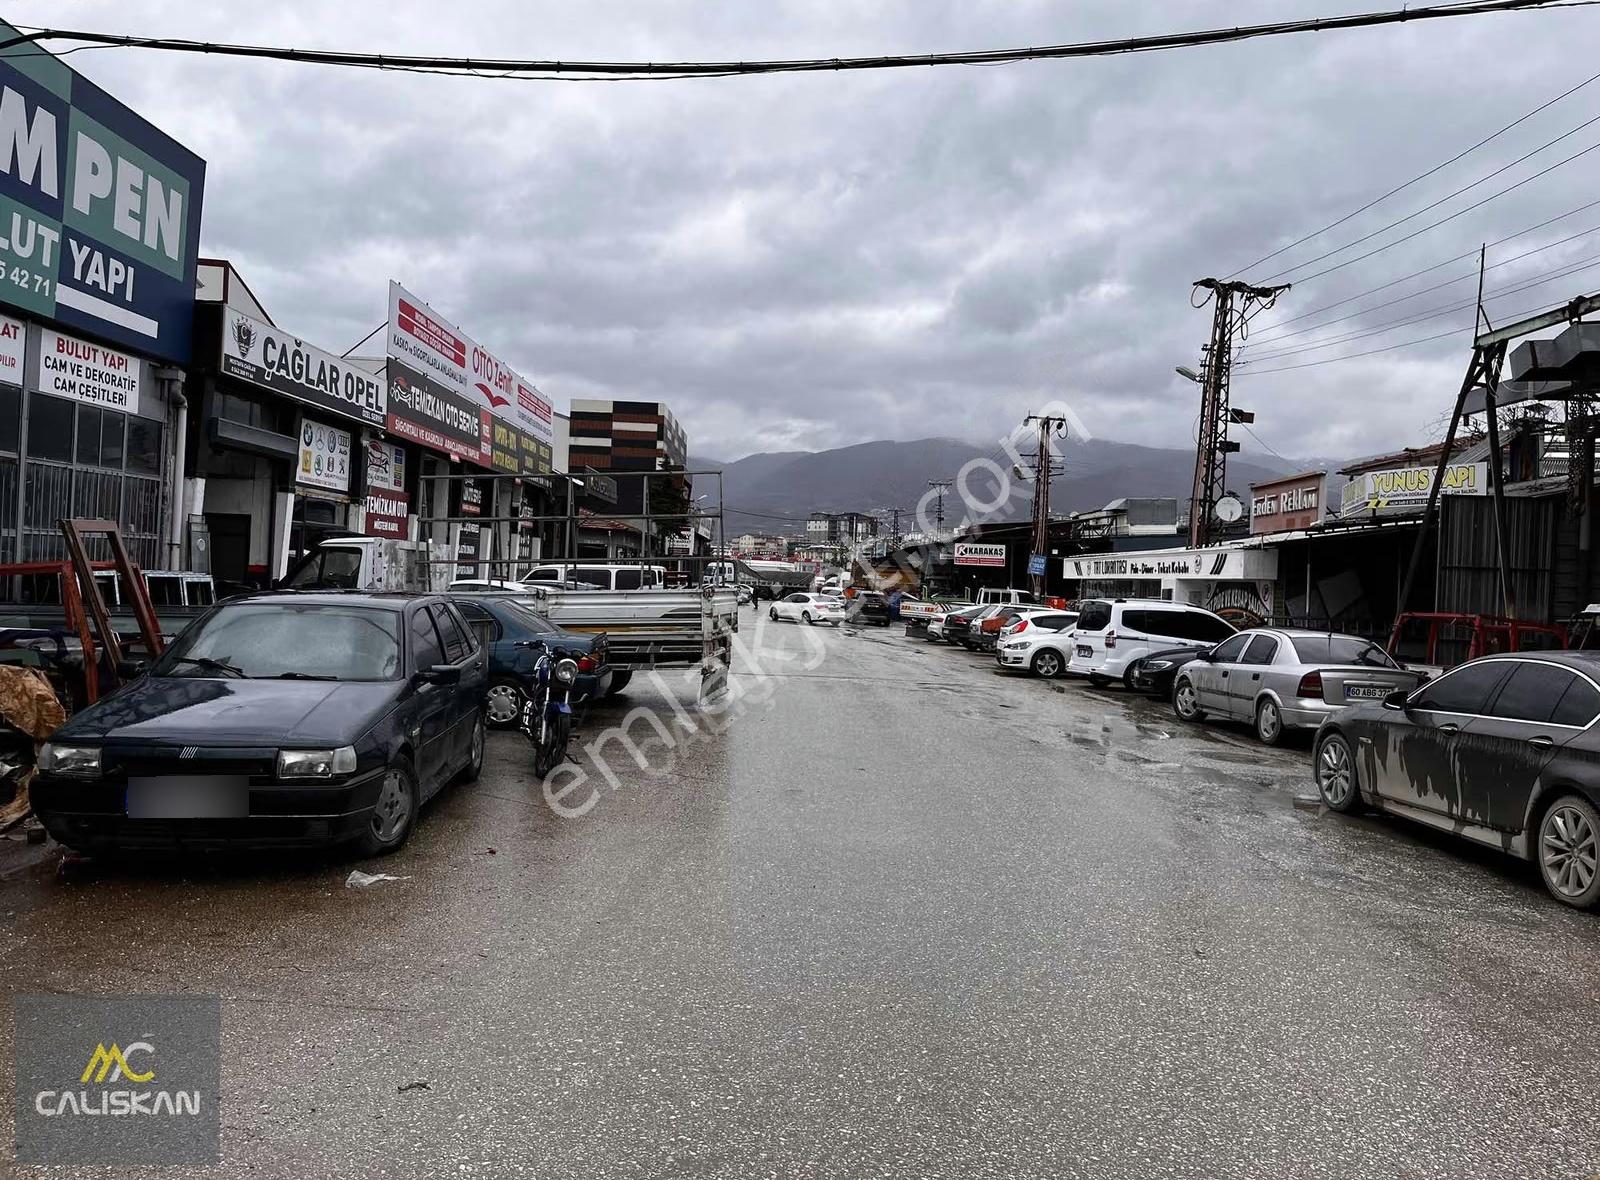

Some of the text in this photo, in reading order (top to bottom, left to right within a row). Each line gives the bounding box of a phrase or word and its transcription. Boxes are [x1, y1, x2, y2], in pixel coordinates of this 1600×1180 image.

[73, 131, 183, 262] PEN
[0, 210, 135, 302] UT YAPI
[10, 266, 29, 289] 42
[34, 274, 51, 297] 71
[0, 322, 20, 341] AT
[56, 337, 129, 374] BULUT YAPI
[473, 346, 493, 382] OTTO
[44, 356, 137, 392] CAM VE DEKORATİF
[54, 376, 128, 407] CAM ÇEŞİTLERİ
[262, 337, 383, 412] ÇAĞLAR OPEL
[411, 385, 479, 437] TEMİZKAN OTO SERVİS
[1371, 468, 1430, 493] YUNUS
[366, 494, 408, 518] TEMİZKAN OTO
[1350, 687, 1361, 697] 60
